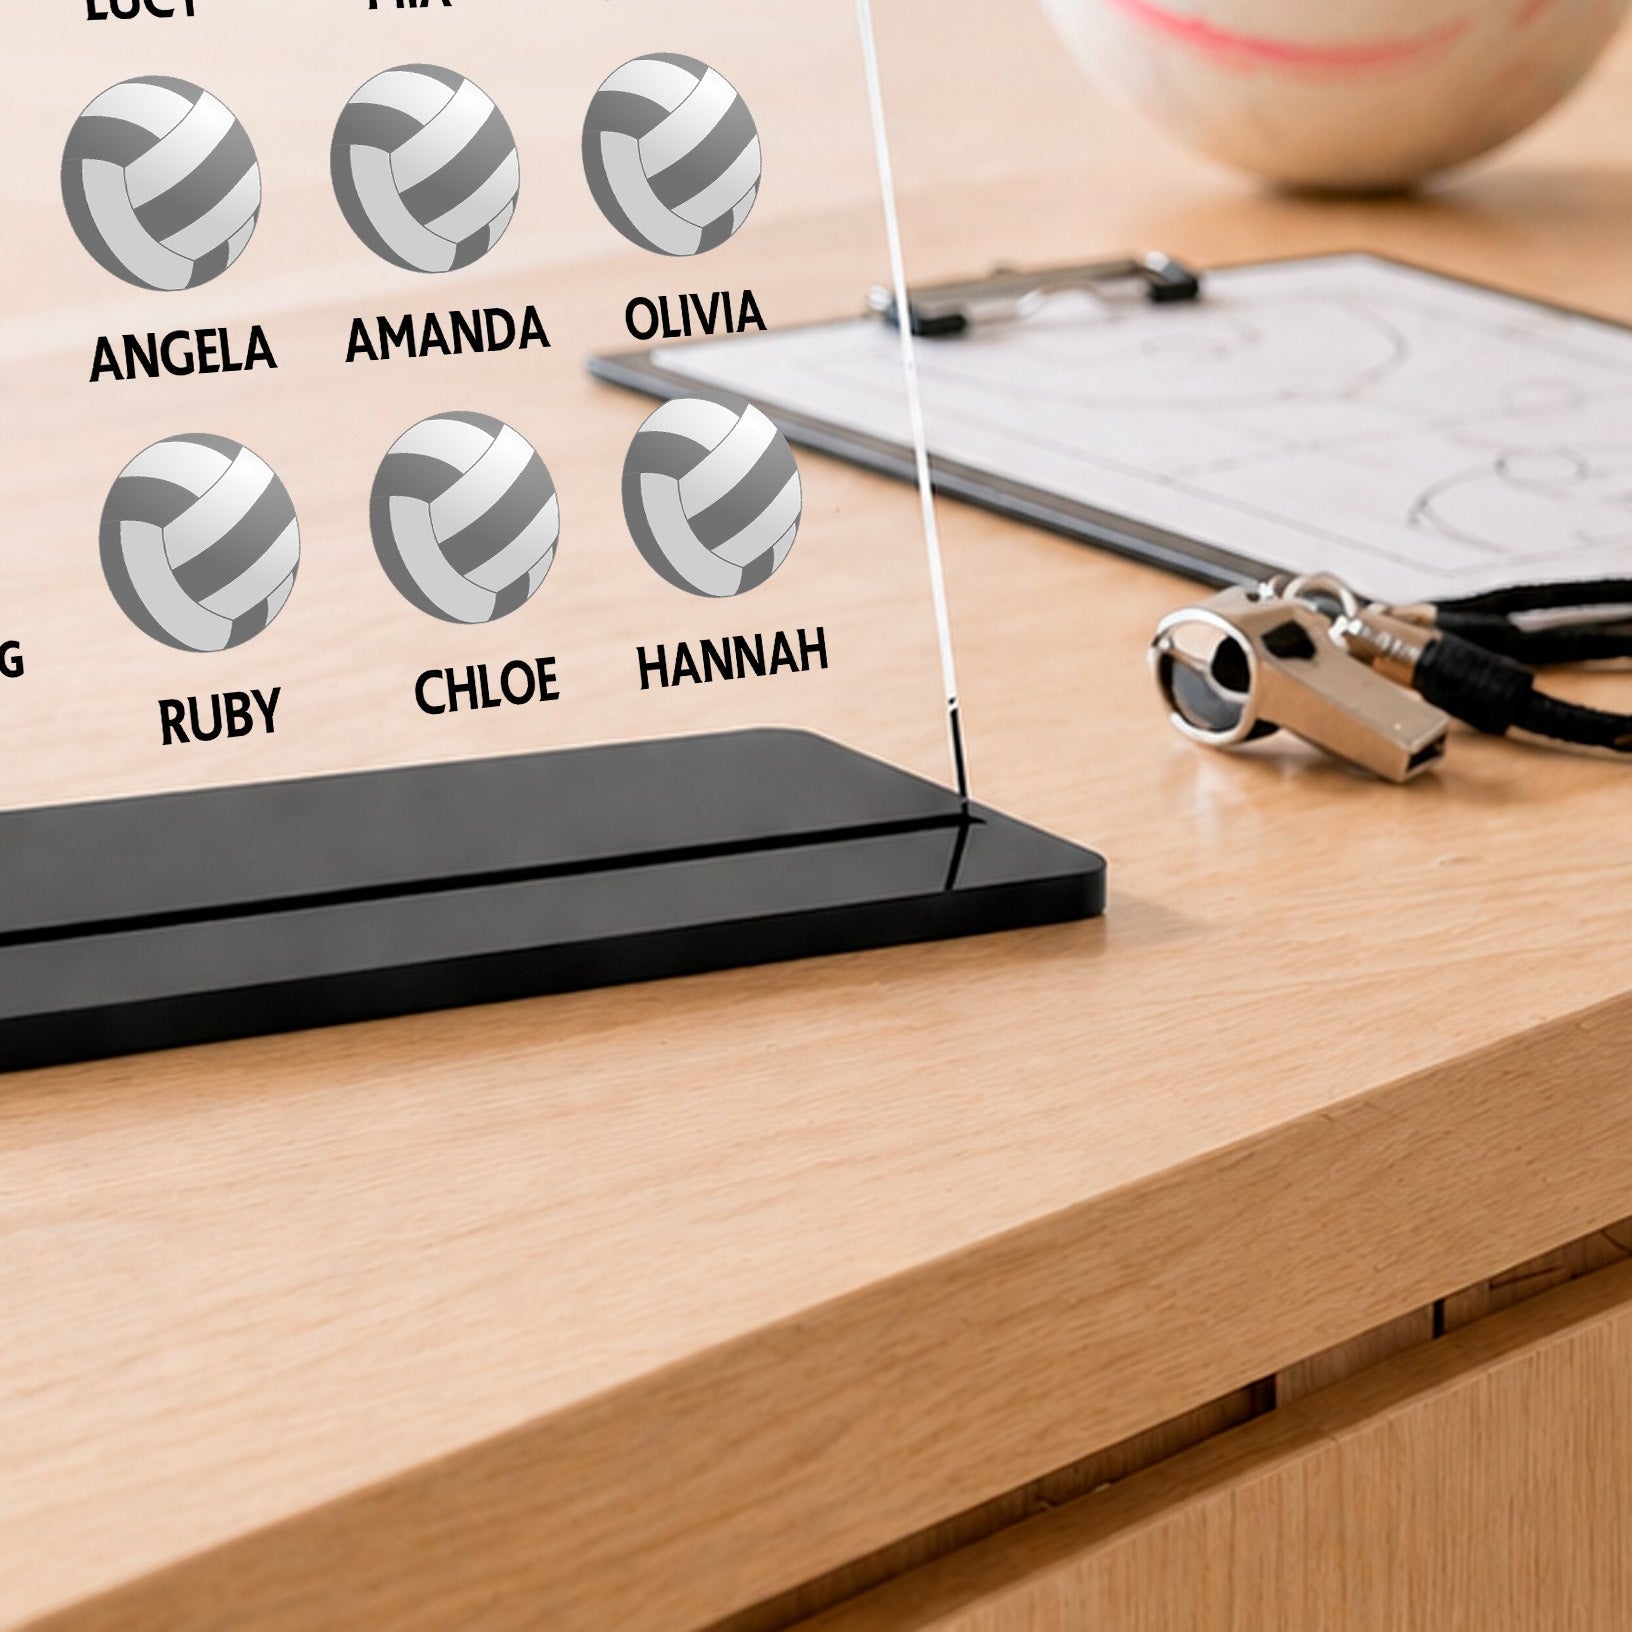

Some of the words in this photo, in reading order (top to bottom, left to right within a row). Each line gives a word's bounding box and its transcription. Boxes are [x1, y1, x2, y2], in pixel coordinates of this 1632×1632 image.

[345, 305, 551, 363] AMANDA
[625, 289, 768, 341] OLIVIA
[89, 324, 278, 383] ANGELA
[414, 656, 560, 715] CHLOE
[636, 626, 828, 690] HANNAH
[158, 686, 281, 746] RUBY
